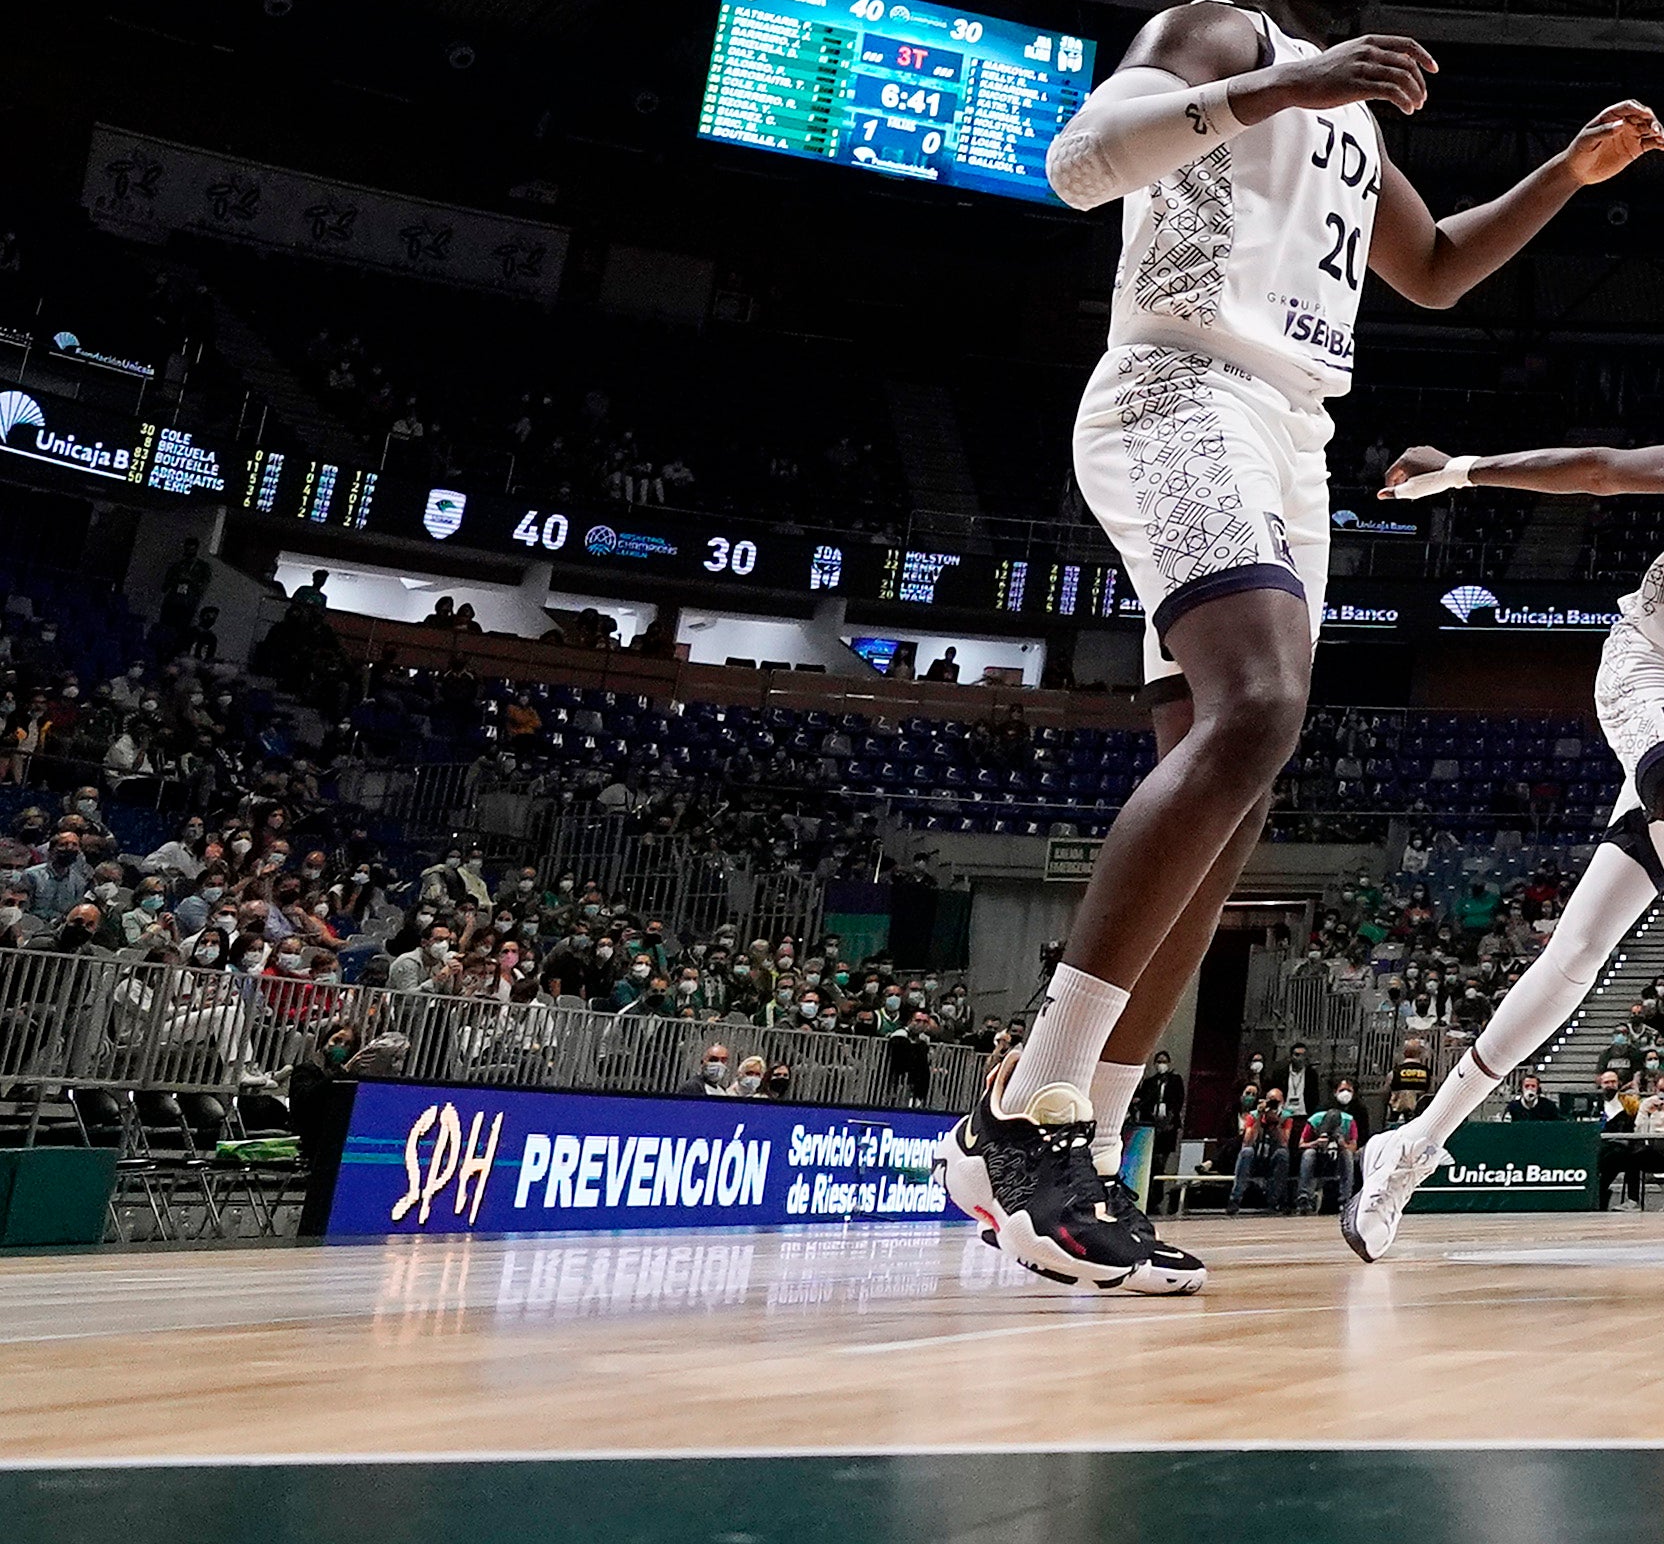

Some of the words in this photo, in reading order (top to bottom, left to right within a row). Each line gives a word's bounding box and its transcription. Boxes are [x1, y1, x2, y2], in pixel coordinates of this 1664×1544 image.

[950, 18, 983, 44] 30
[897, 45, 928, 69] 3T
[881, 83, 941, 118] 6:41
[862, 118, 878, 142] 1
[922, 131, 941, 155] 0
[140, 422, 155, 436] 30
[160, 427, 193, 445] COLE
[36, 428, 112, 470] Unicaja
[113, 449, 129, 470] B
[133, 447, 149, 460] 83
[154, 452, 219, 477] BOUTEILLE
[157, 440, 216, 463] BRIZUELA
[246, 460, 259, 473] 11
[127, 471, 143, 484] 50
[163, 478, 192, 494] ERIC
[130, 458, 145, 472] 21
[150, 465, 225, 491] ABROMAITIS
[513, 510, 568, 551] 40
[703, 537, 757, 576] 30
[903, 562, 945, 574] HENRY
[905, 551, 961, 566] HOLSTON
[1340, 605, 1399, 622] Banco
[1494, 606, 1564, 628] Unicaja
[1566, 608, 1623, 626] Banco
[788, 1125, 857, 1168] Servicio
[514, 1124, 771, 1209] PREVENCIÓN
[1449, 1163, 1524, 1187] Unicaja
[1526, 1165, 1588, 1182] Banco
[787, 1182, 808, 1214] de
[811, 1180, 876, 1216] Riesgos
[877, 1174, 947, 1214] Laborales
